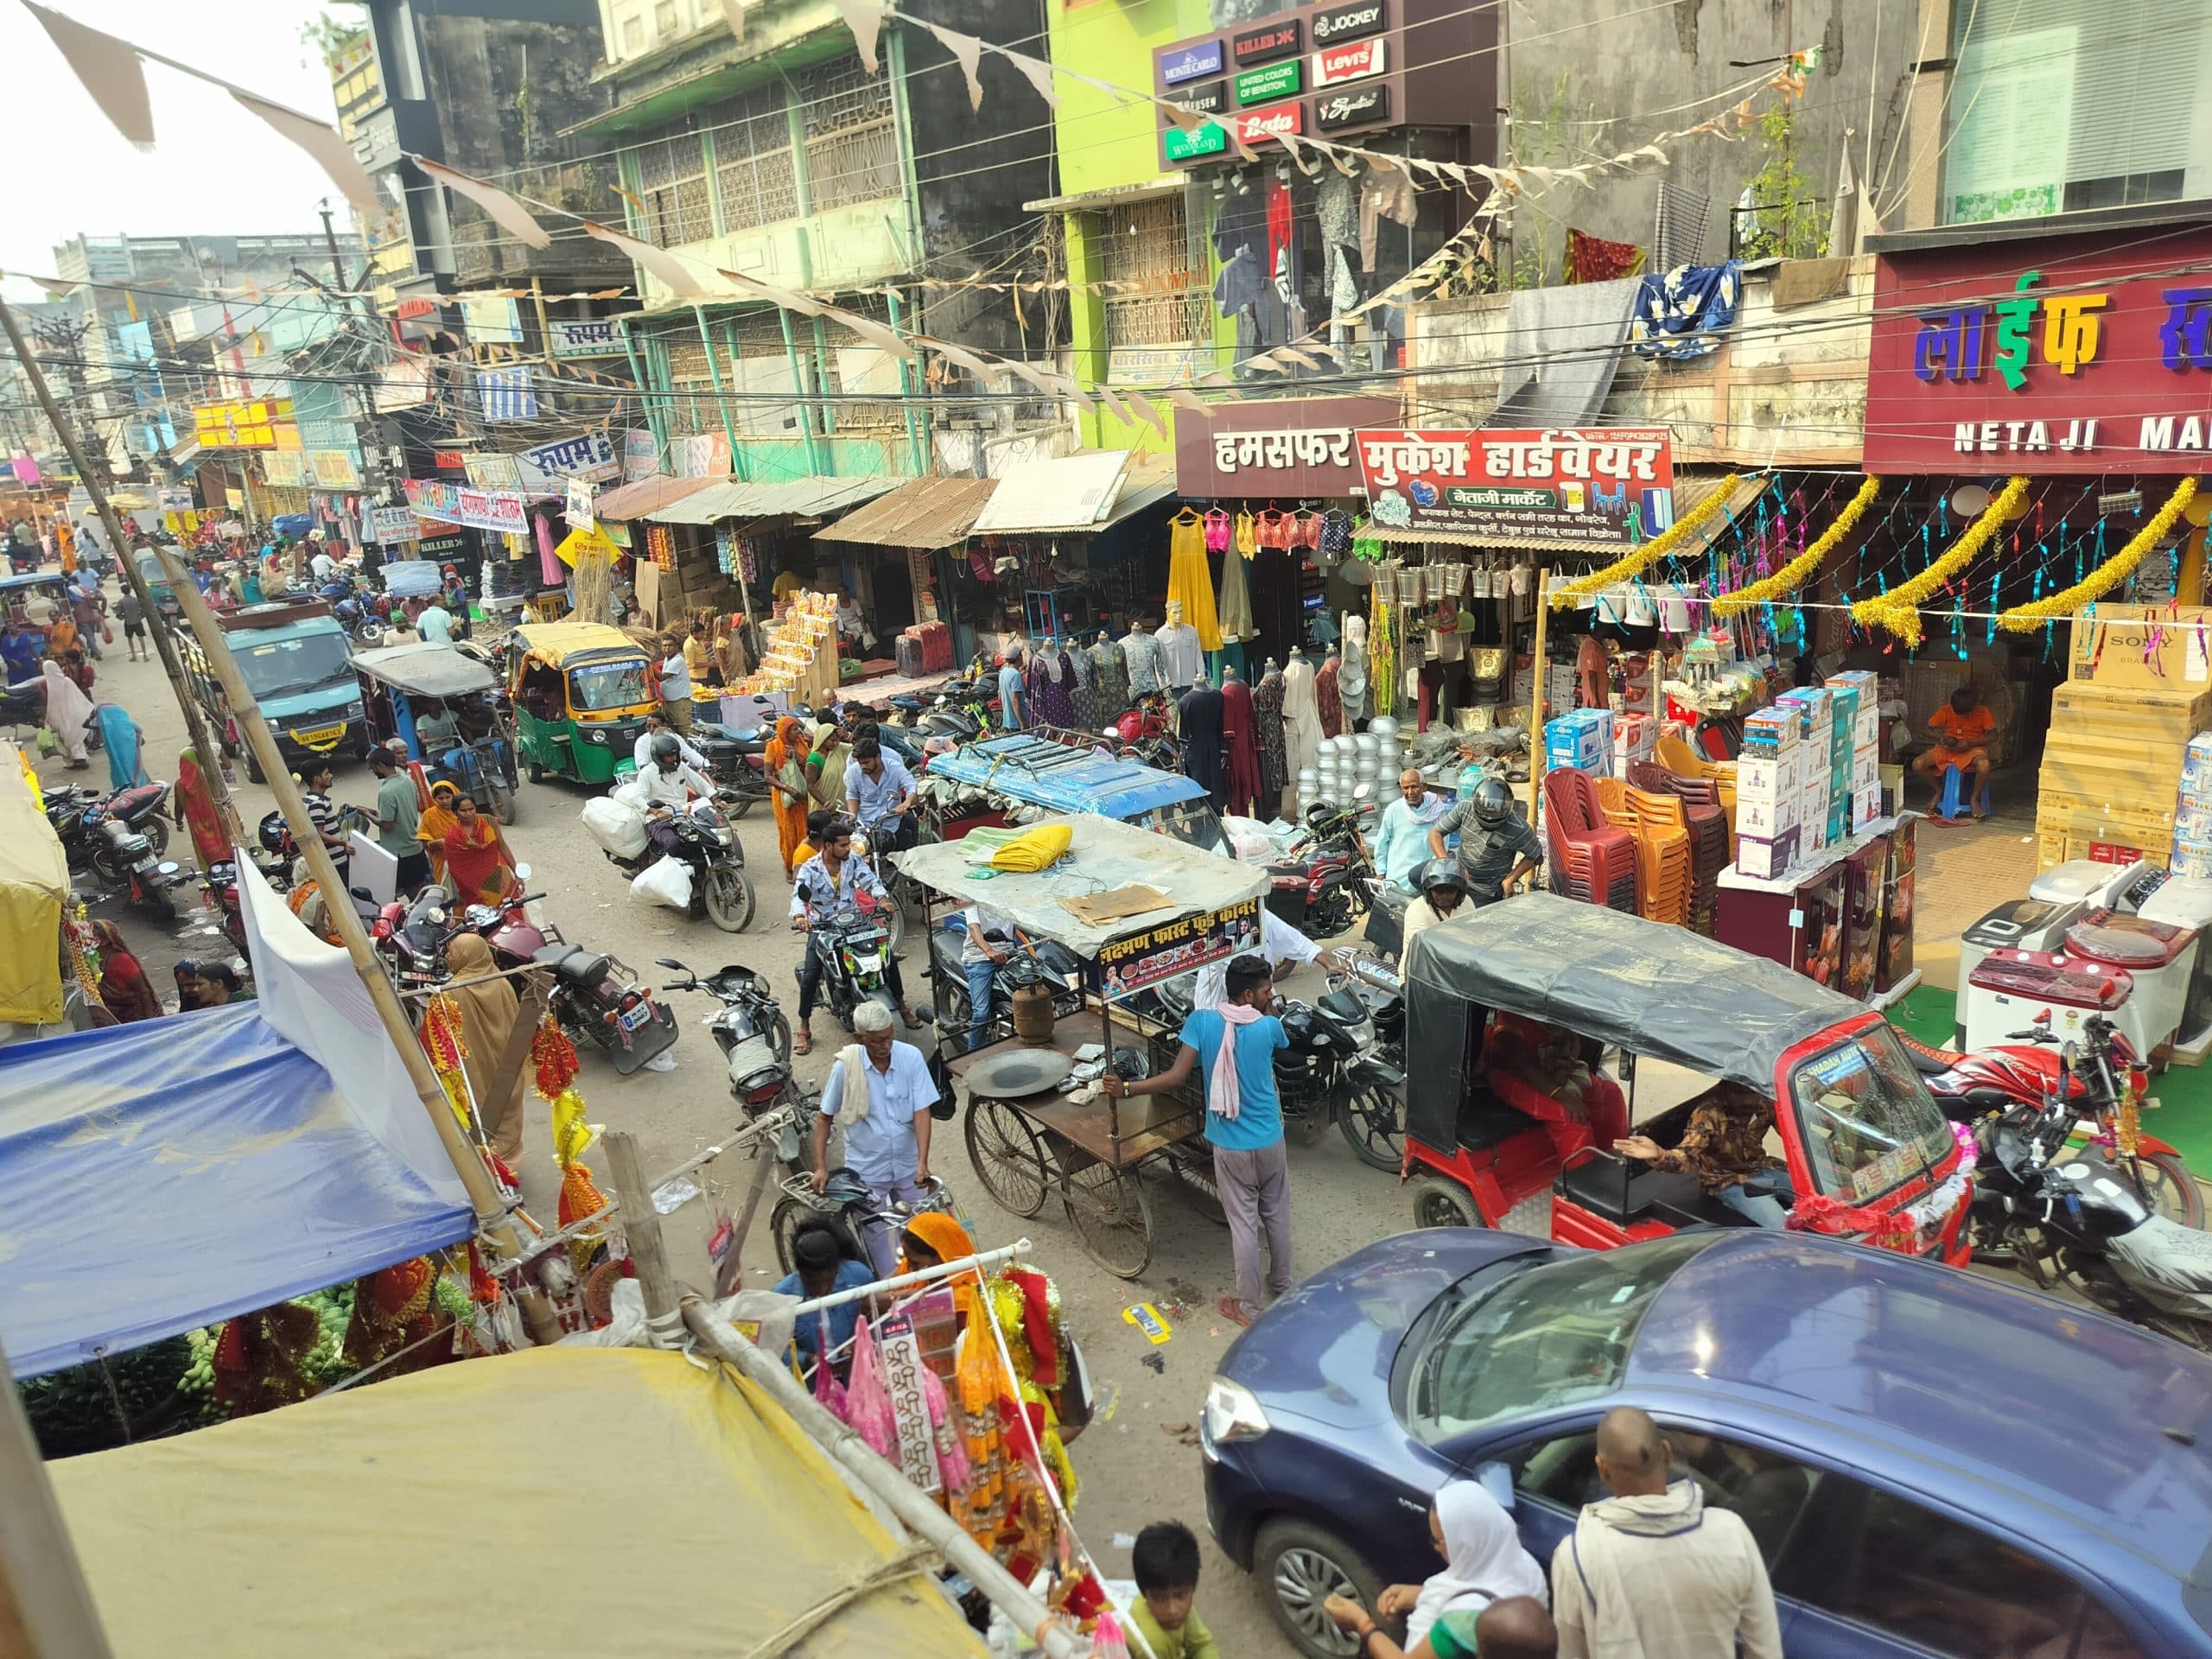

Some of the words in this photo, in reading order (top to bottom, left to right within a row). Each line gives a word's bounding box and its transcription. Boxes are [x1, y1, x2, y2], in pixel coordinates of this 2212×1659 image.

[1330, 8, 1380, 32] JOCKEY
[1236, 35, 1276, 56] KILLER
[1165, 62, 1192, 80] MONTE
[1192, 56, 1218, 73] CARLO
[1239, 74, 1264, 87] UNITED
[1264, 67, 1294, 81] COLORS
[1240, 87, 1252, 98] OF
[1243, 113, 1294, 138] Bata
[1173, 137, 1217, 156] WOODLAND
[1914, 270, 2110, 391] लाईफ
[1954, 418, 2100, 452] NETAJI
[2139, 416, 2212, 450] MA
[530, 435, 597, 478] रूपम
[1213, 428, 1354, 474] हमसफर
[1363, 436, 1468, 486] मुकेश
[1482, 429, 1662, 480] हार्डवेयर
[1452, 487, 1499, 505] नेताजी
[1501, 488, 1548, 507] मार्केट
[421, 538, 455, 552] KILLER
[2120, 657, 2157, 665] BRAVA
